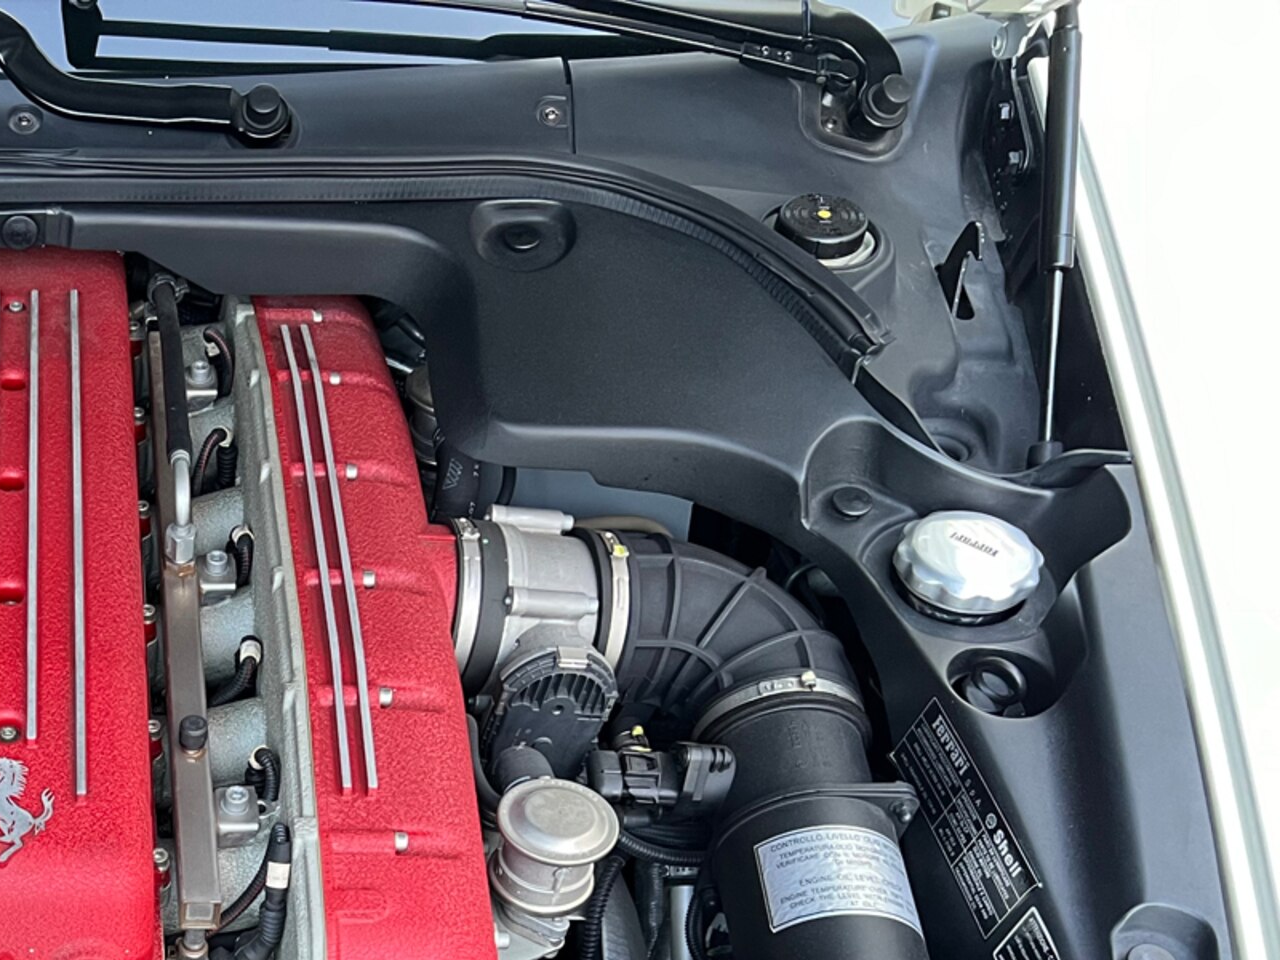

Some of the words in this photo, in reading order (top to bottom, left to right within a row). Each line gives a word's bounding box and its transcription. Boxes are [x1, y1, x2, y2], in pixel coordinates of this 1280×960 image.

[932, 714, 969, 774] Ferrari
[993, 829, 1021, 877] Shell
[770, 833, 824, 853] CONTROLLO
[826, 833, 860, 842] LIVELLO
[798, 875, 832, 887] ENGINE
